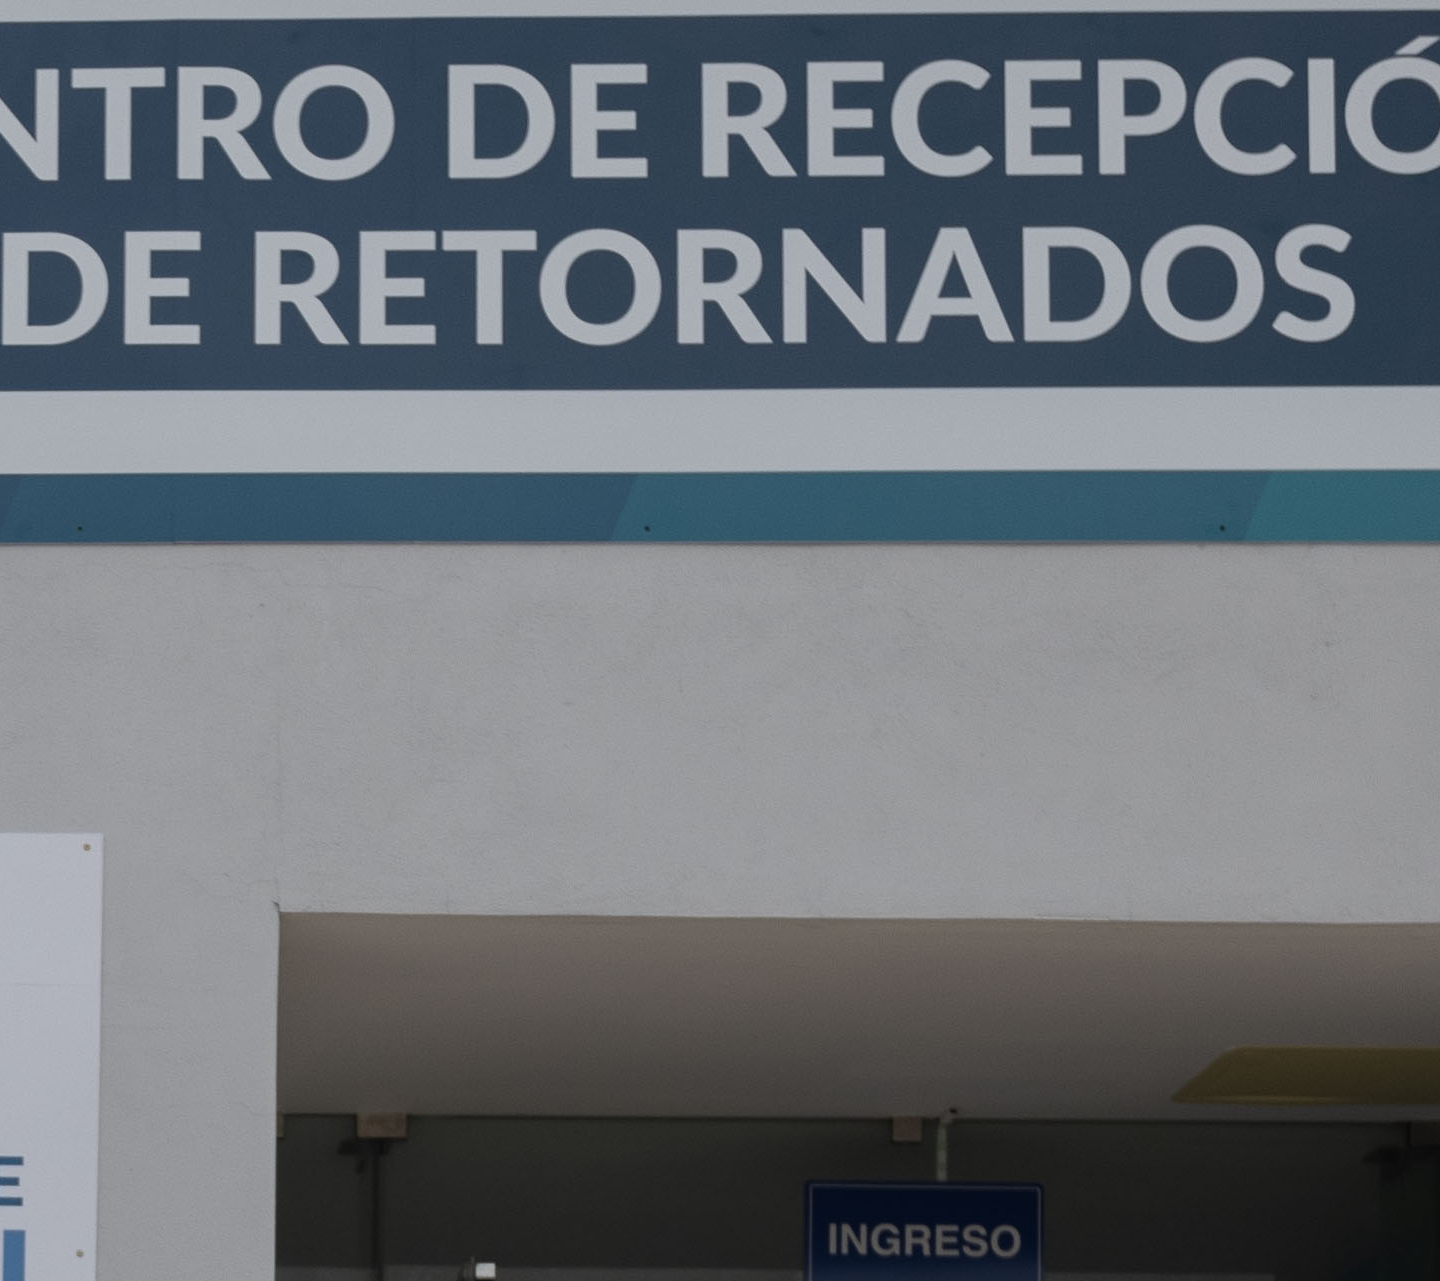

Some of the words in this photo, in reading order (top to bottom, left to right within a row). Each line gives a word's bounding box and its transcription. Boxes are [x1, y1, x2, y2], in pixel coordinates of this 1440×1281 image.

[448, 63, 648, 179] DE
[1, 230, 202, 346] DE
[254, 223, 1356, 346] RETORNADOS
[829, 1223, 1021, 1258] INGRESO
